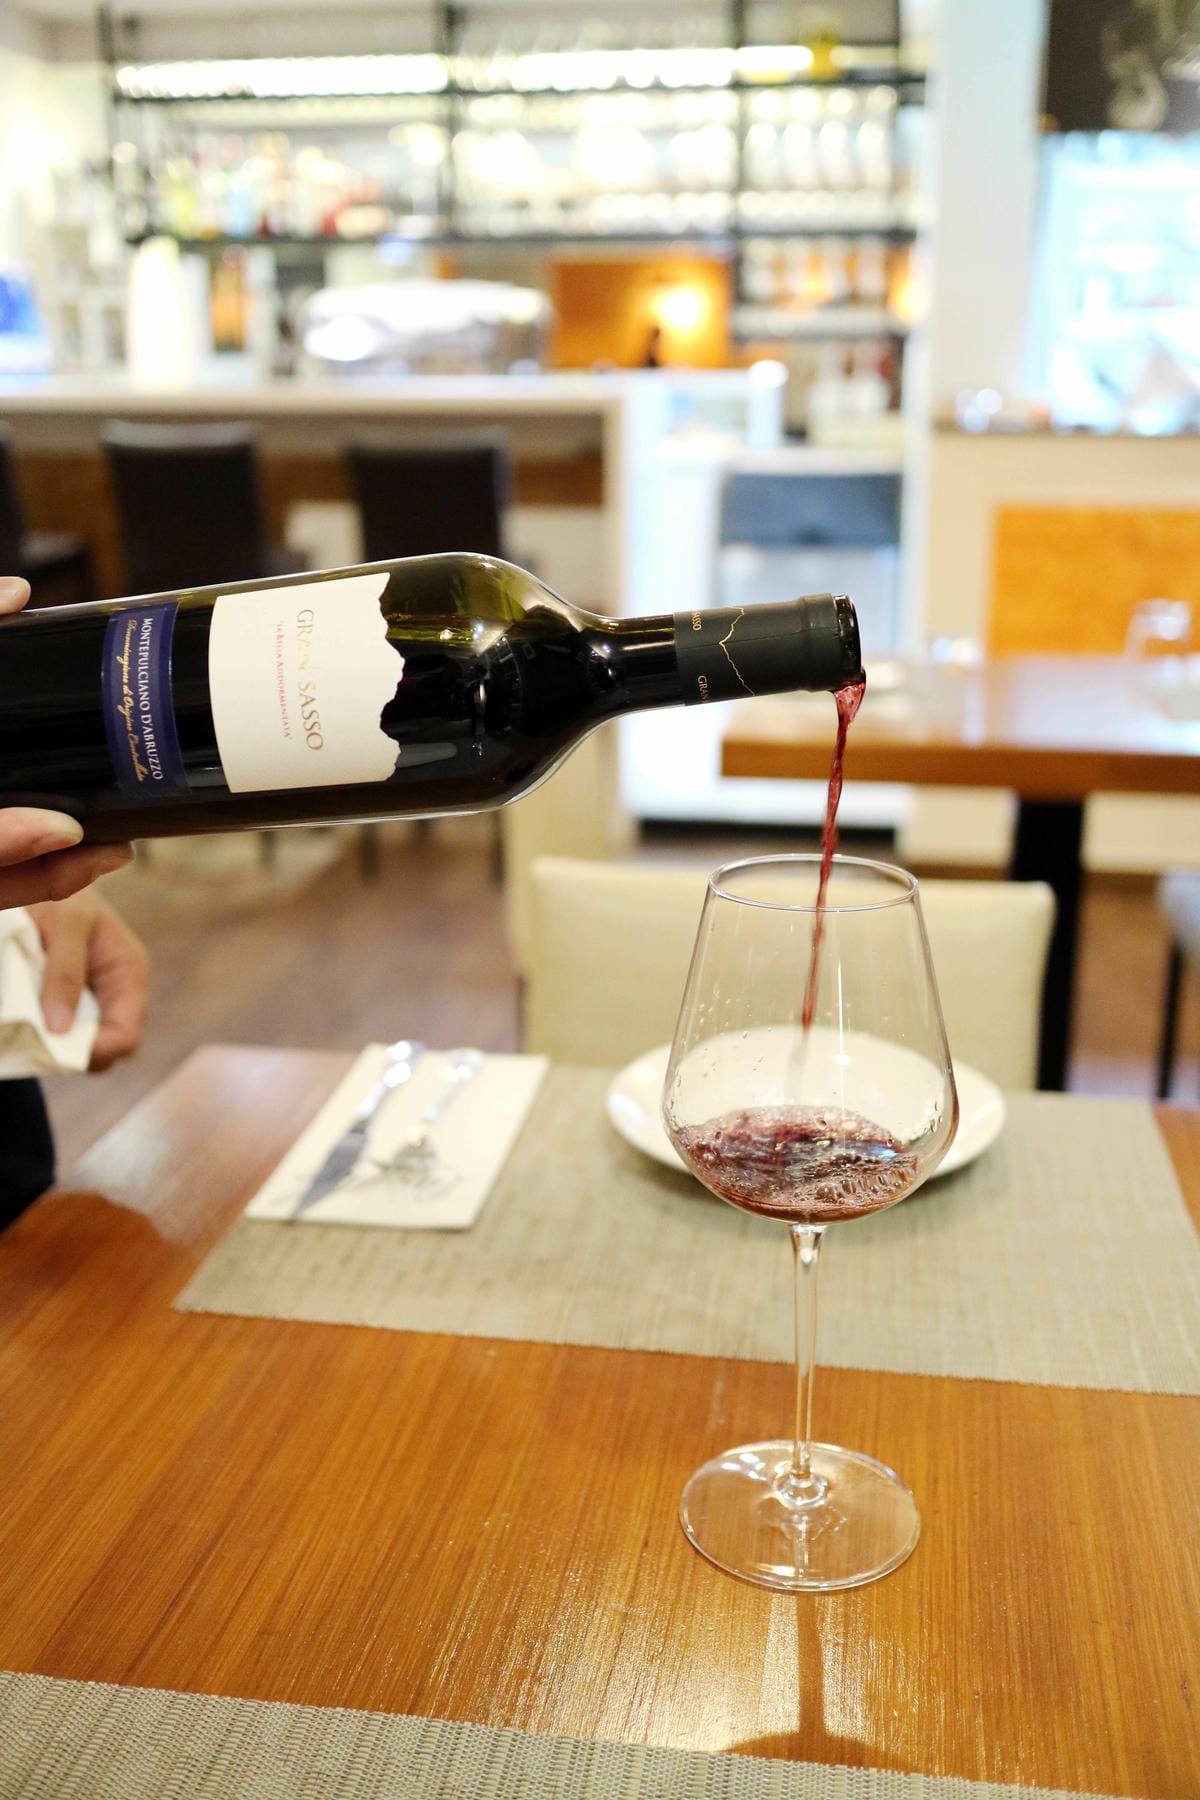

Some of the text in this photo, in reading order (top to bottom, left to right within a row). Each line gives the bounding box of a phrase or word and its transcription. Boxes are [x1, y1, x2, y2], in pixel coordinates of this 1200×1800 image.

[116, 619, 149, 782] Denominazione di Origine Controllata
[137, 618, 164, 780] MONTEPULCIANO D'ABRUZZO
[298, 609, 324, 751] GRAN SASSO
[698, 675, 709, 701] GRAN
